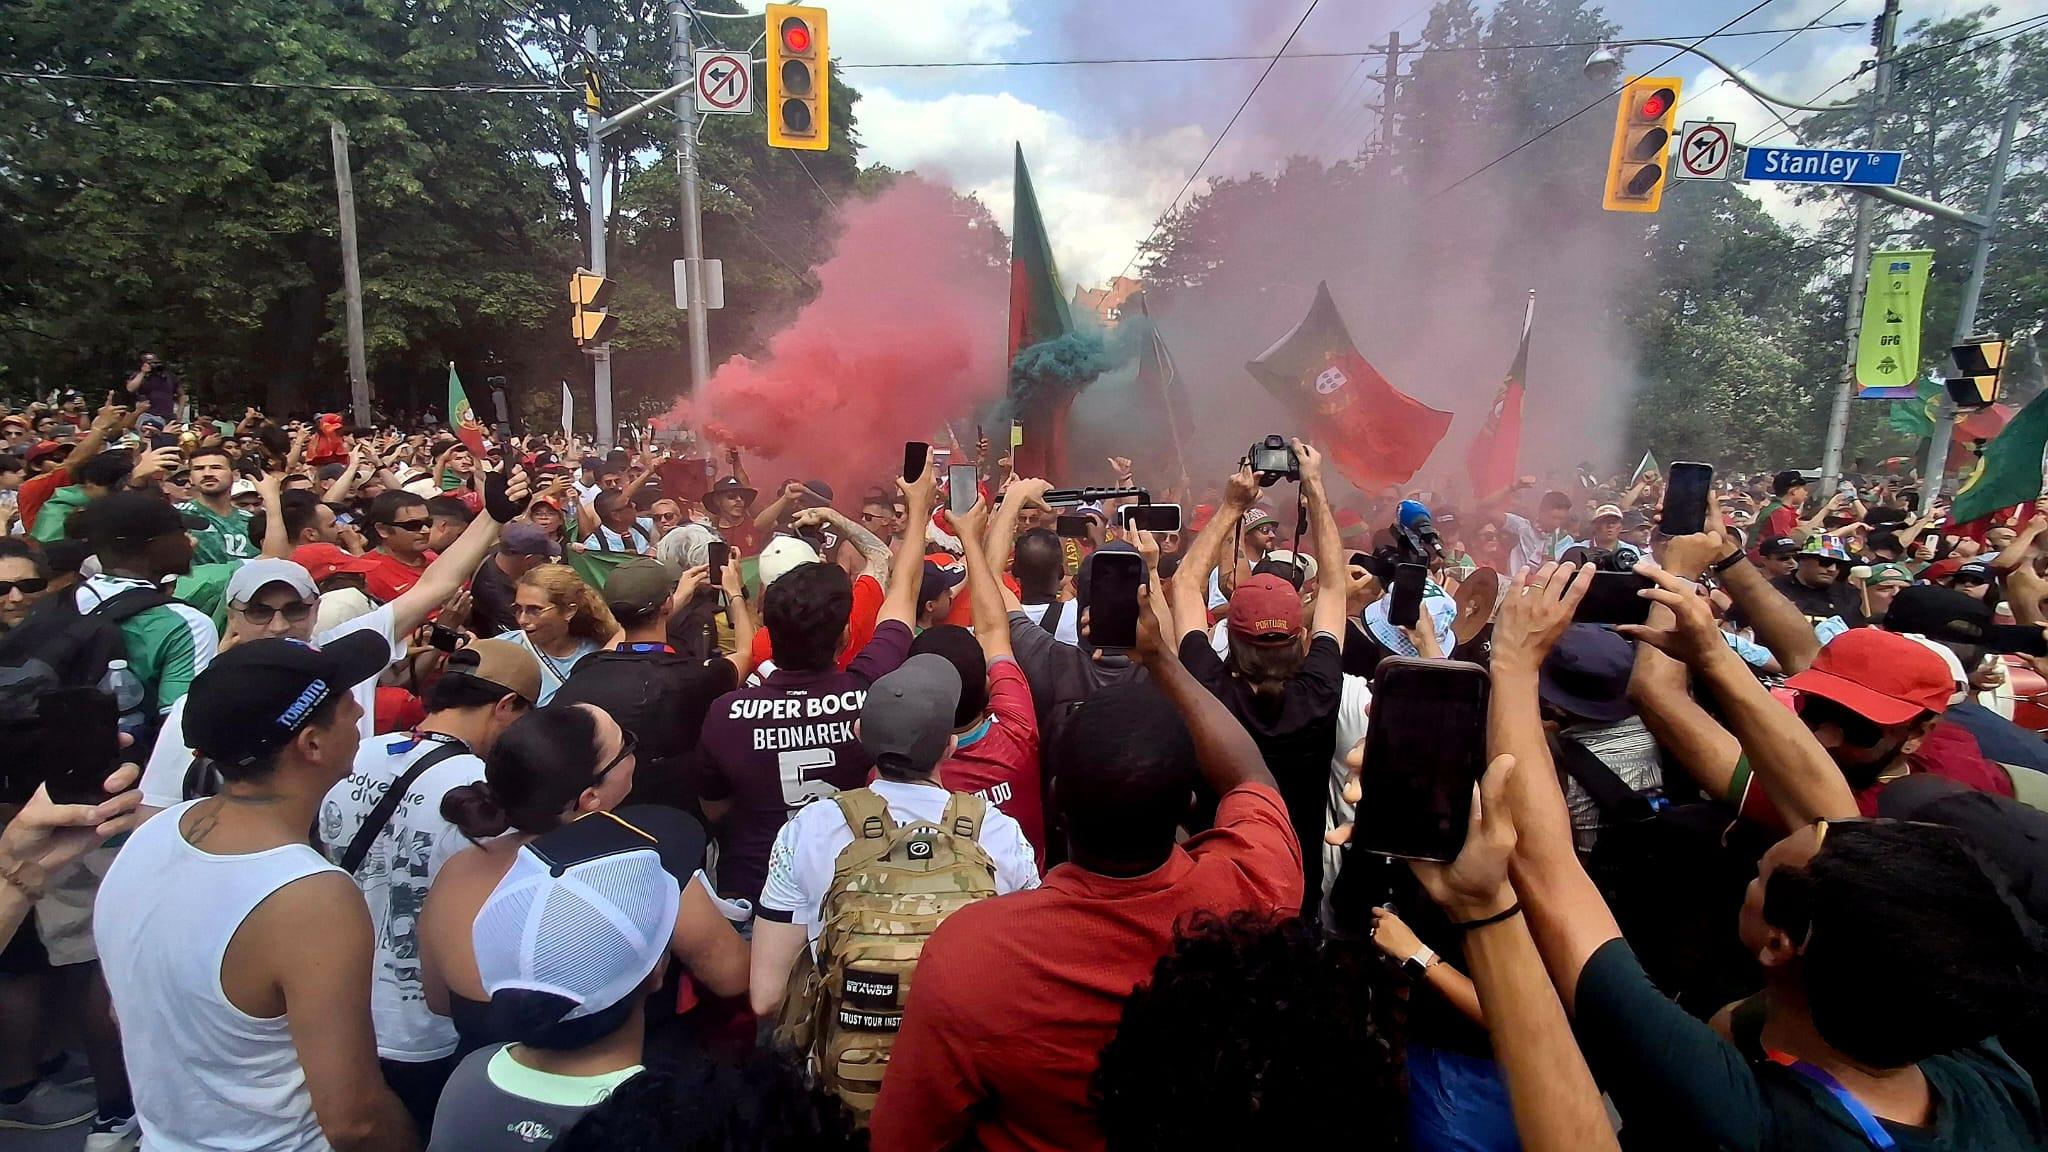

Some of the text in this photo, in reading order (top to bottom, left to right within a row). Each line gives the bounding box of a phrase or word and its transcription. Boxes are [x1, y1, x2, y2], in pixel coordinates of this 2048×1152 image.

[1765, 150, 1881, 180] Stanley Te
[1881, 335, 1901, 346] OPG
[1255, 619, 1288, 630] PORTUGAL
[276, 679, 326, 726] TORONTO
[728, 689, 867, 719] SUPER BOCK
[753, 720, 855, 750] BEDNAREK
[347, 772, 425, 805] adveure
[778, 747, 840, 806] 5
[846, 984, 858, 992] BE
[866, 986, 893, 995] WOLF
[840, 1012, 903, 1027] TRUST YOUR INST
